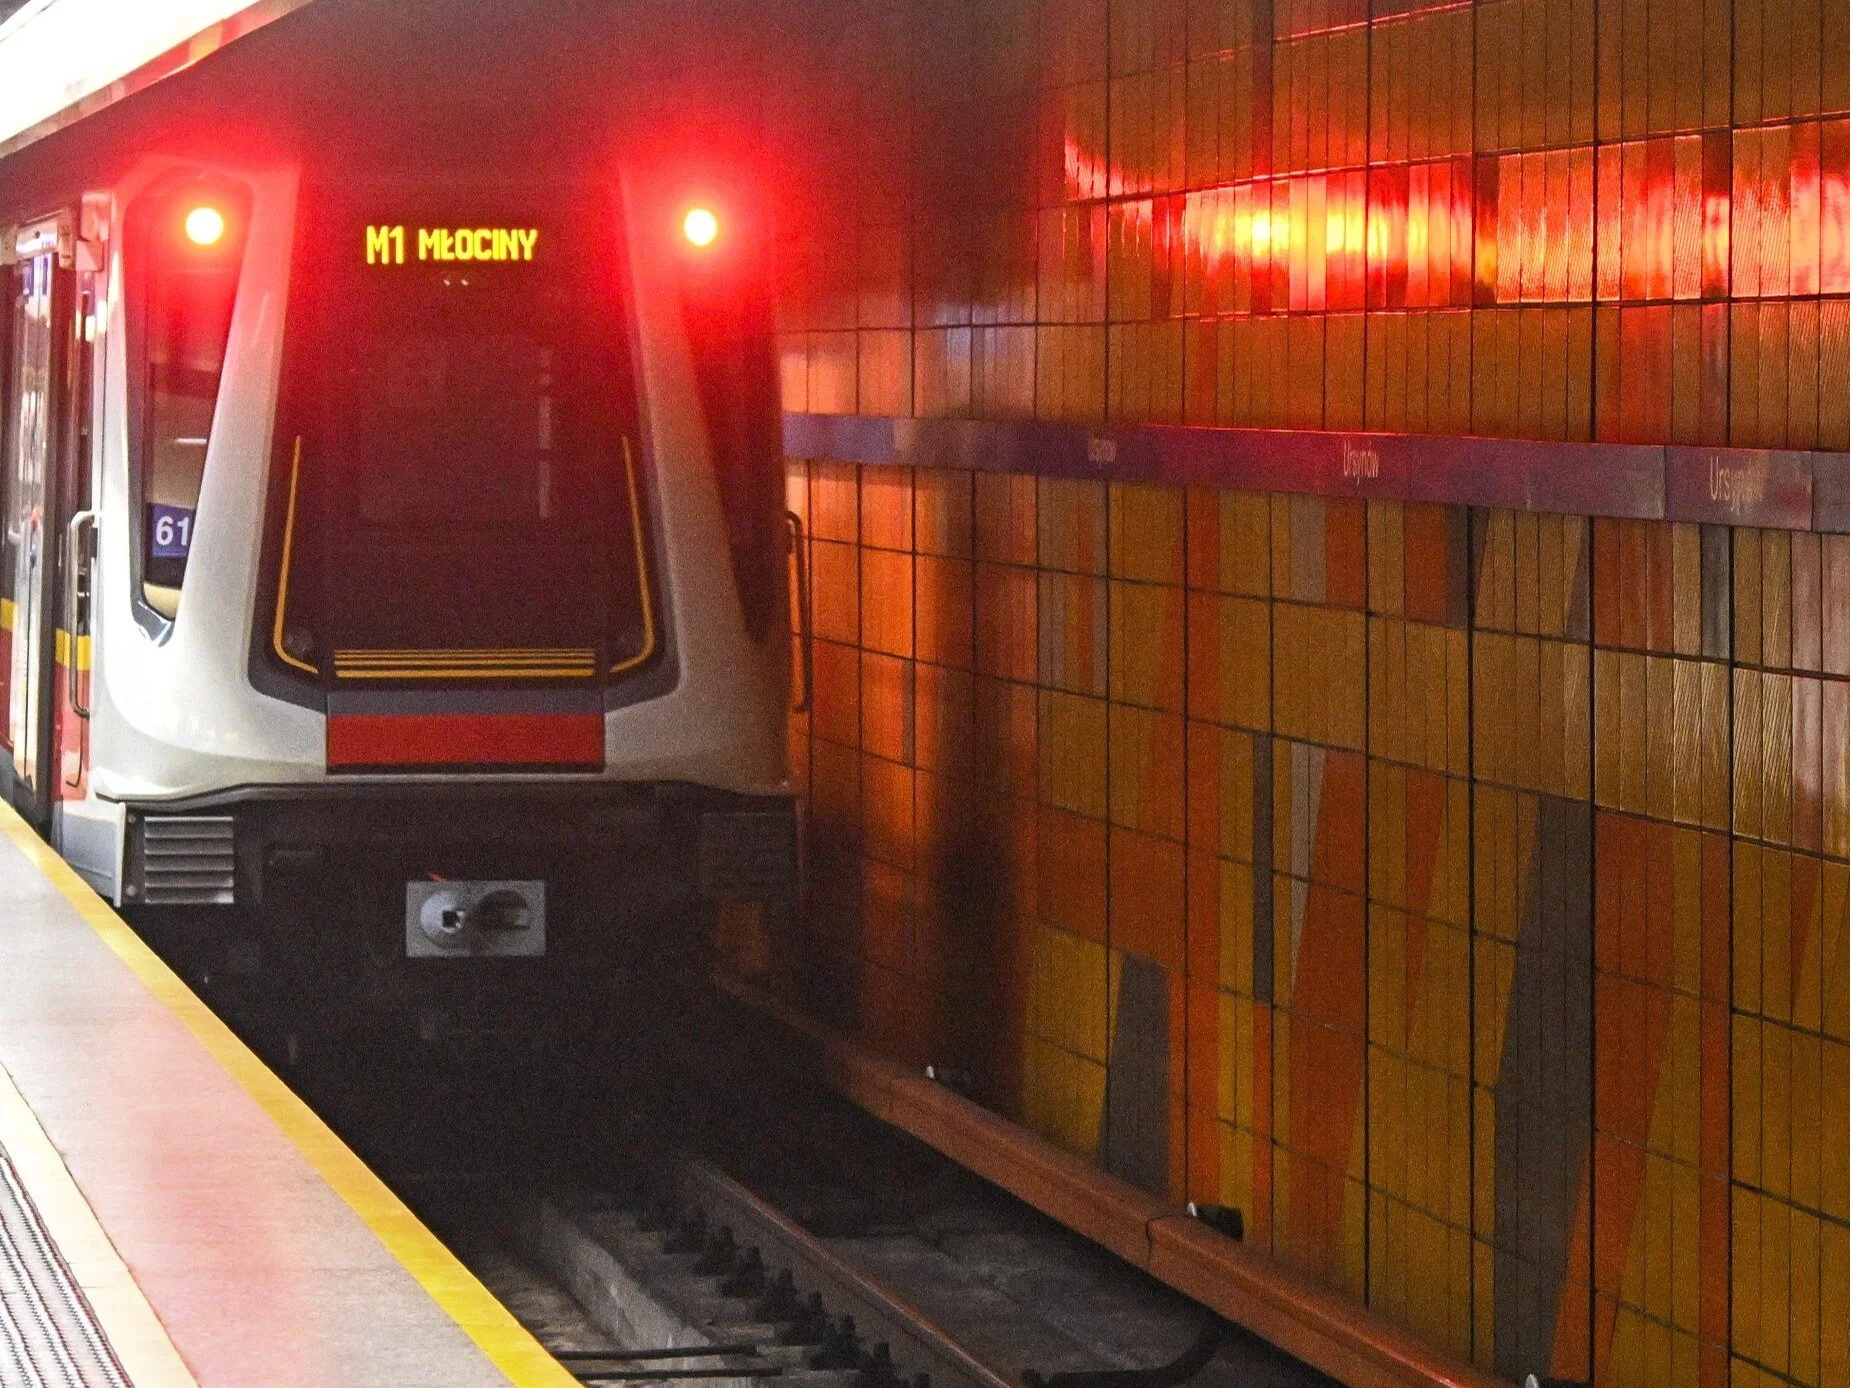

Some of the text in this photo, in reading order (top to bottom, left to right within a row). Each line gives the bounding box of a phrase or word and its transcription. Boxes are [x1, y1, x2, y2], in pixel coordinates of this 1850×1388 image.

[367, 225, 538, 265] M1 MŁOCINY
[156, 515, 189, 546] 61
